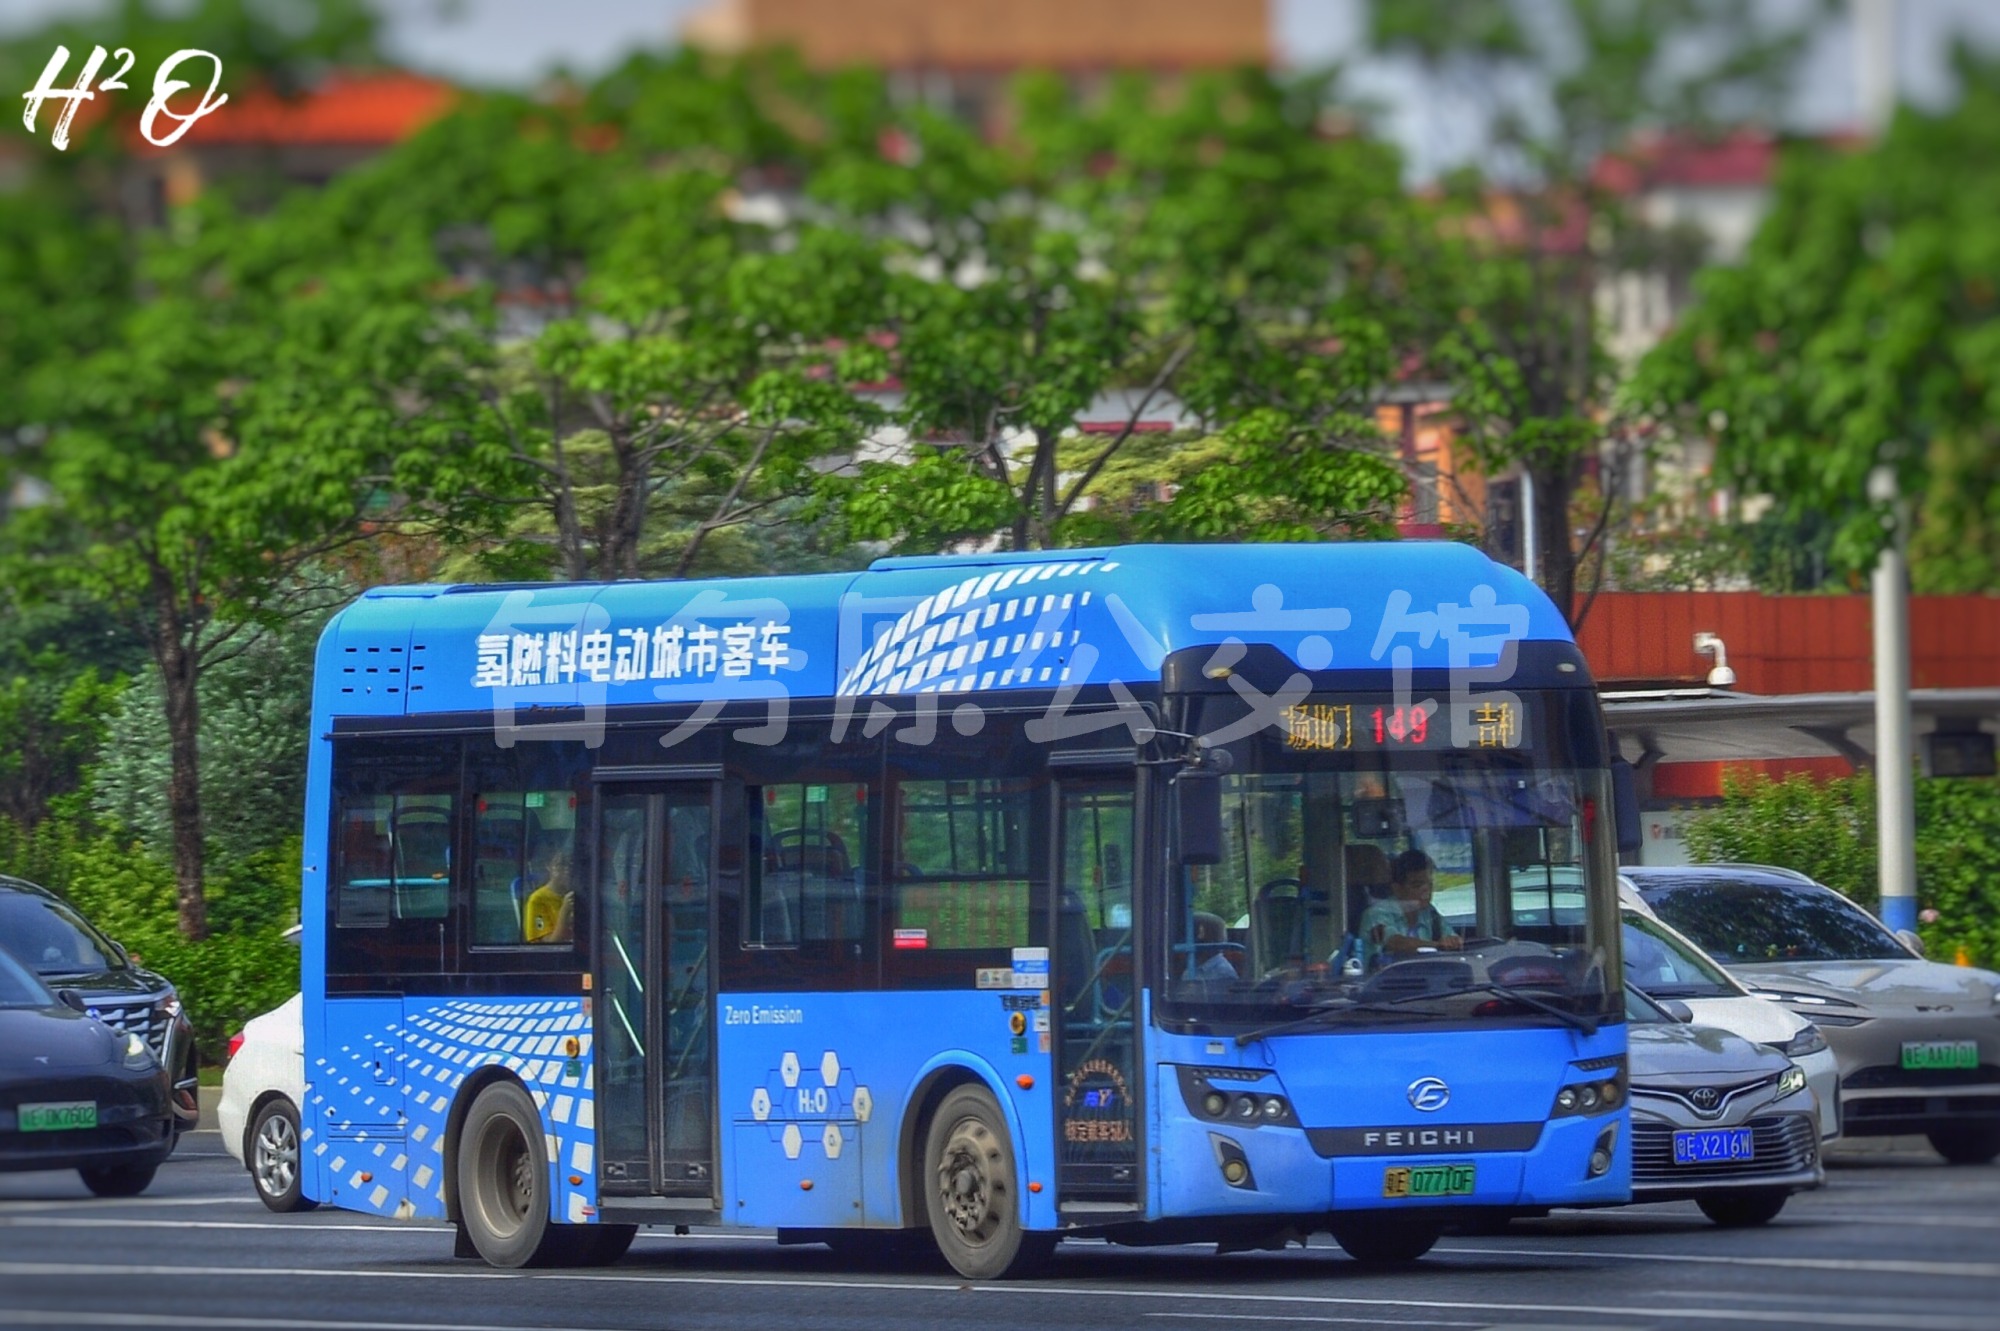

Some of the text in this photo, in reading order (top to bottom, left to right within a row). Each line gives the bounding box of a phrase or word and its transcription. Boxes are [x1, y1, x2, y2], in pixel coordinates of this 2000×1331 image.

[475, 620, 792, 687] 氢燃料电动城市客车
[1371, 706, 1428, 744] 149
[725, 1004, 803, 1024] Zero Emission
[1364, 1130, 1474, 1147] FEICHI
